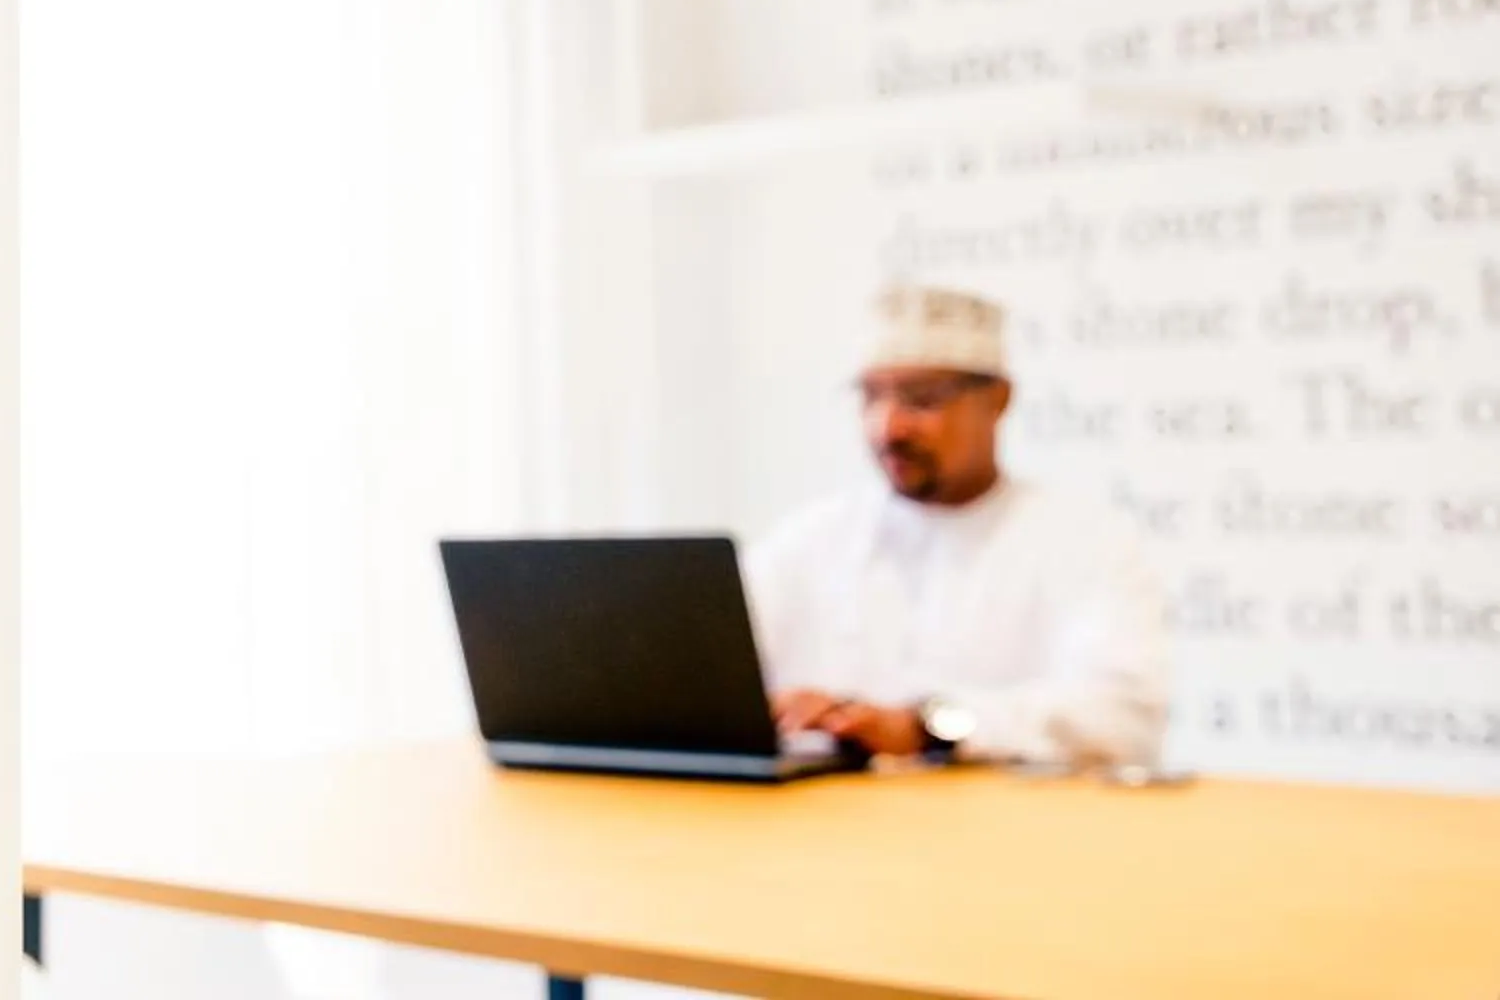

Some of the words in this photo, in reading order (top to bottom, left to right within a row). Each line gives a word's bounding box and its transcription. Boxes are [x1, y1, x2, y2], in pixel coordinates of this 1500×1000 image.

[1080, 22, 1155, 73] or
[1118, 198, 1266, 250] over
[1287, 187, 1400, 264] my
[1276, 362, 1438, 440] The
[1285, 562, 1372, 642] of
